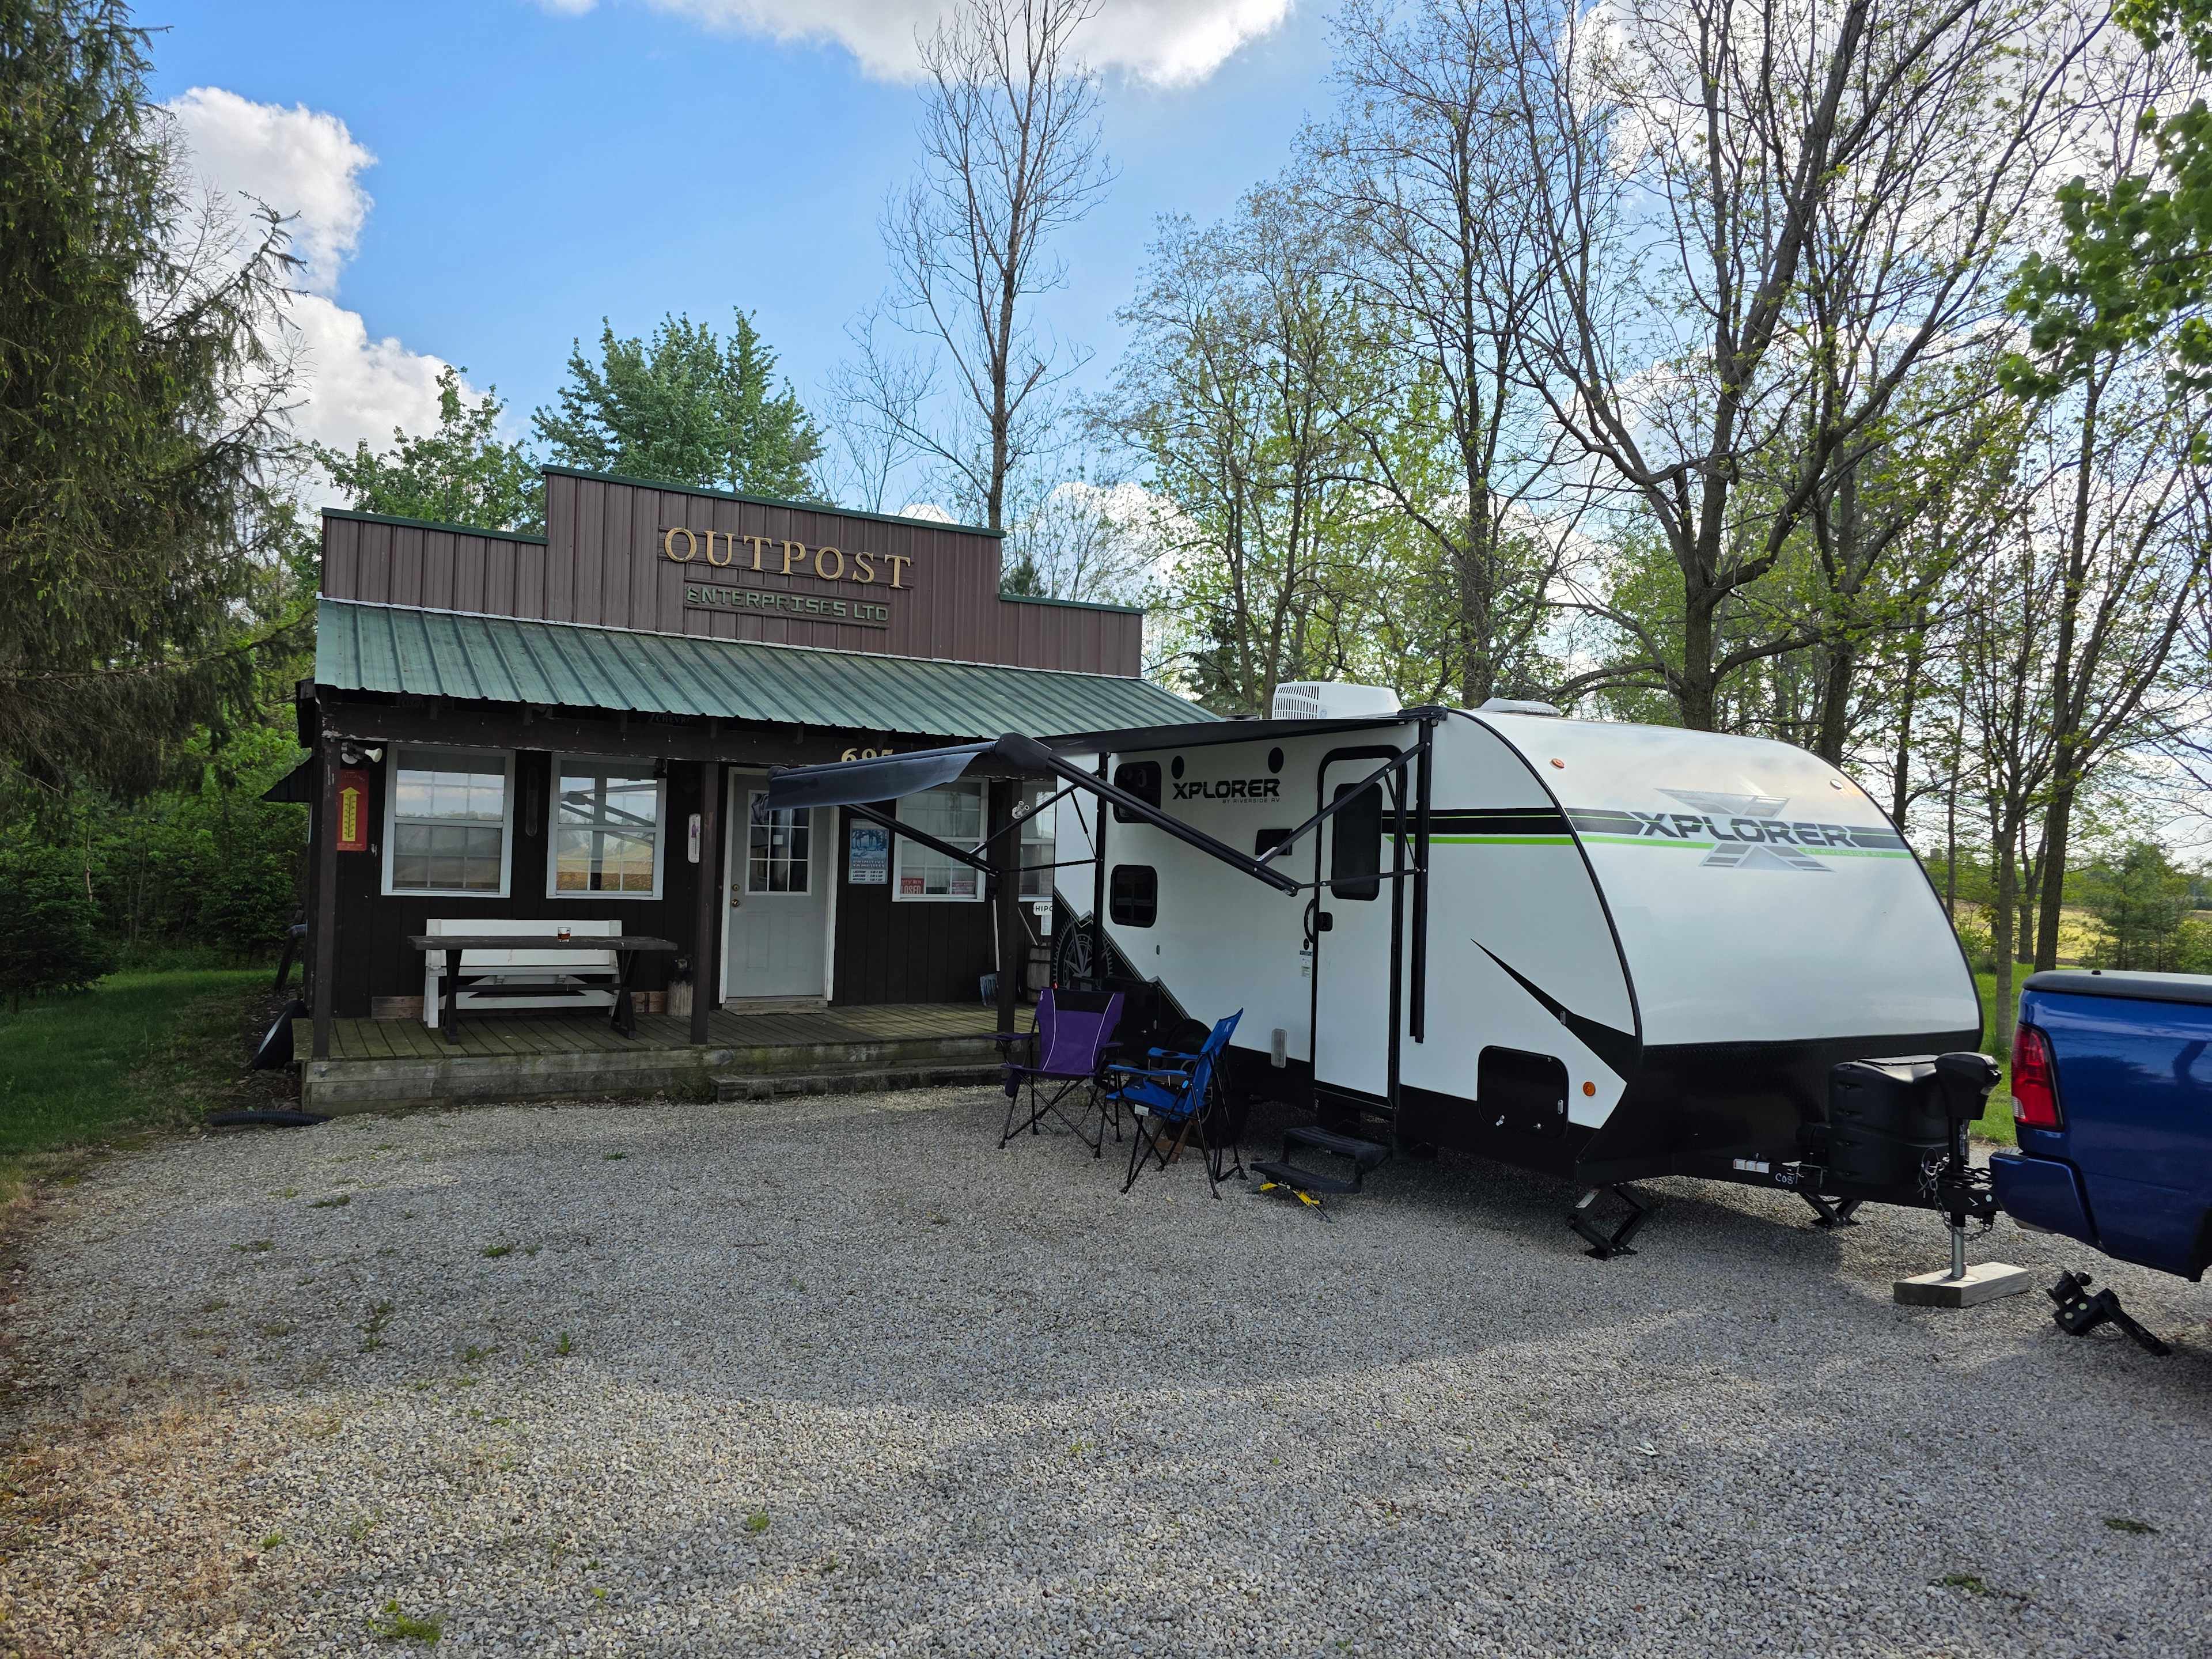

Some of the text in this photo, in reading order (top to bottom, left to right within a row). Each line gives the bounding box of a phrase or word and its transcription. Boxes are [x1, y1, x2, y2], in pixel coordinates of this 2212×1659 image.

[664, 527, 910, 589] OUTPOST
[686, 586, 889, 622] ENTERPRISES LTD
[1172, 778, 1281, 800] XPLORER
[1630, 812, 1857, 847] XPLORER
